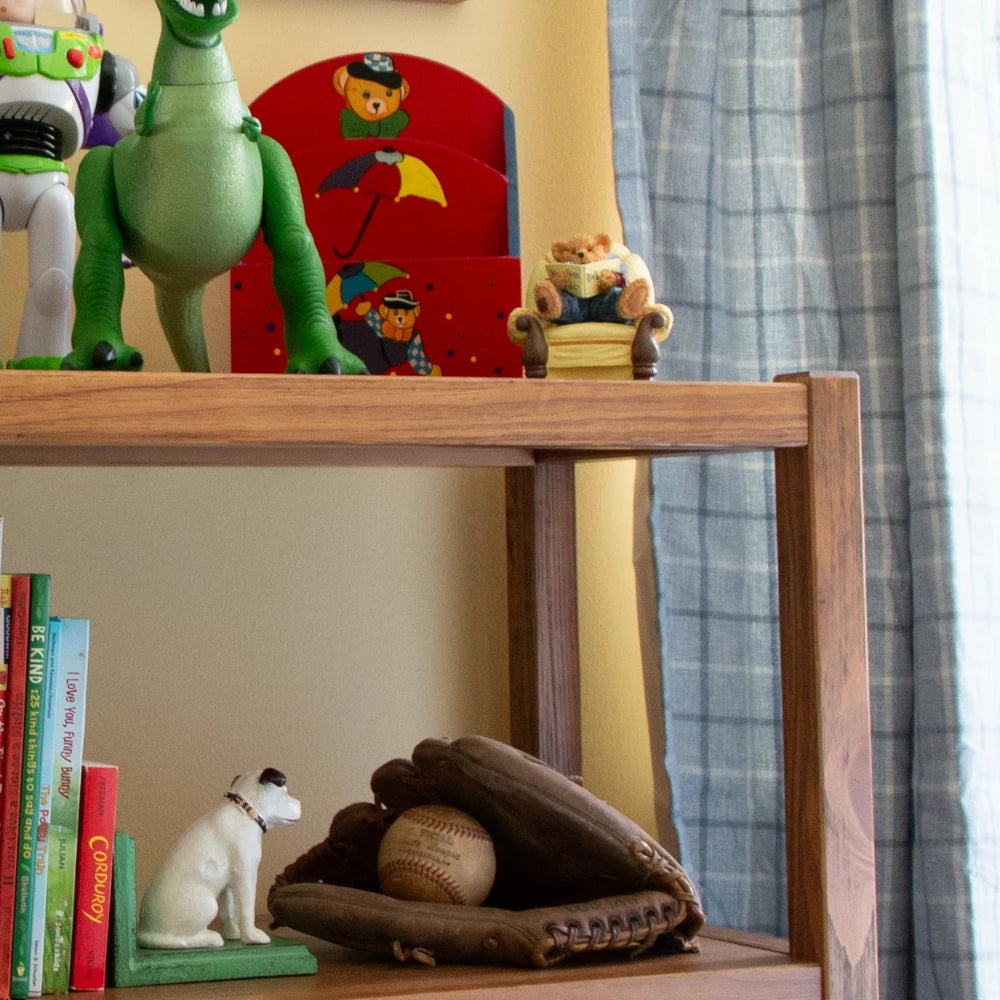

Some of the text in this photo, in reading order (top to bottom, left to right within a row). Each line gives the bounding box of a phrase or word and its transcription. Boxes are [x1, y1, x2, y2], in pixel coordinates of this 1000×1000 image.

[30, 626, 46, 642] BE
[30, 689, 40, 708] 125
[65, 678, 78, 703] Love
[28, 711, 39, 736] kind
[62, 707, 76, 728] You,
[26, 738, 38, 775] things
[60, 731, 75, 762] Funny
[25, 777, 34, 791] to
[58, 767, 73, 799] Bunny
[24, 794, 34, 814] say
[40, 785, 50, 805] The
[24, 818, 32, 841] and
[23, 843, 31, 859] do
[36, 847, 47, 875] Train
[59, 837, 67, 869] JULIAN
